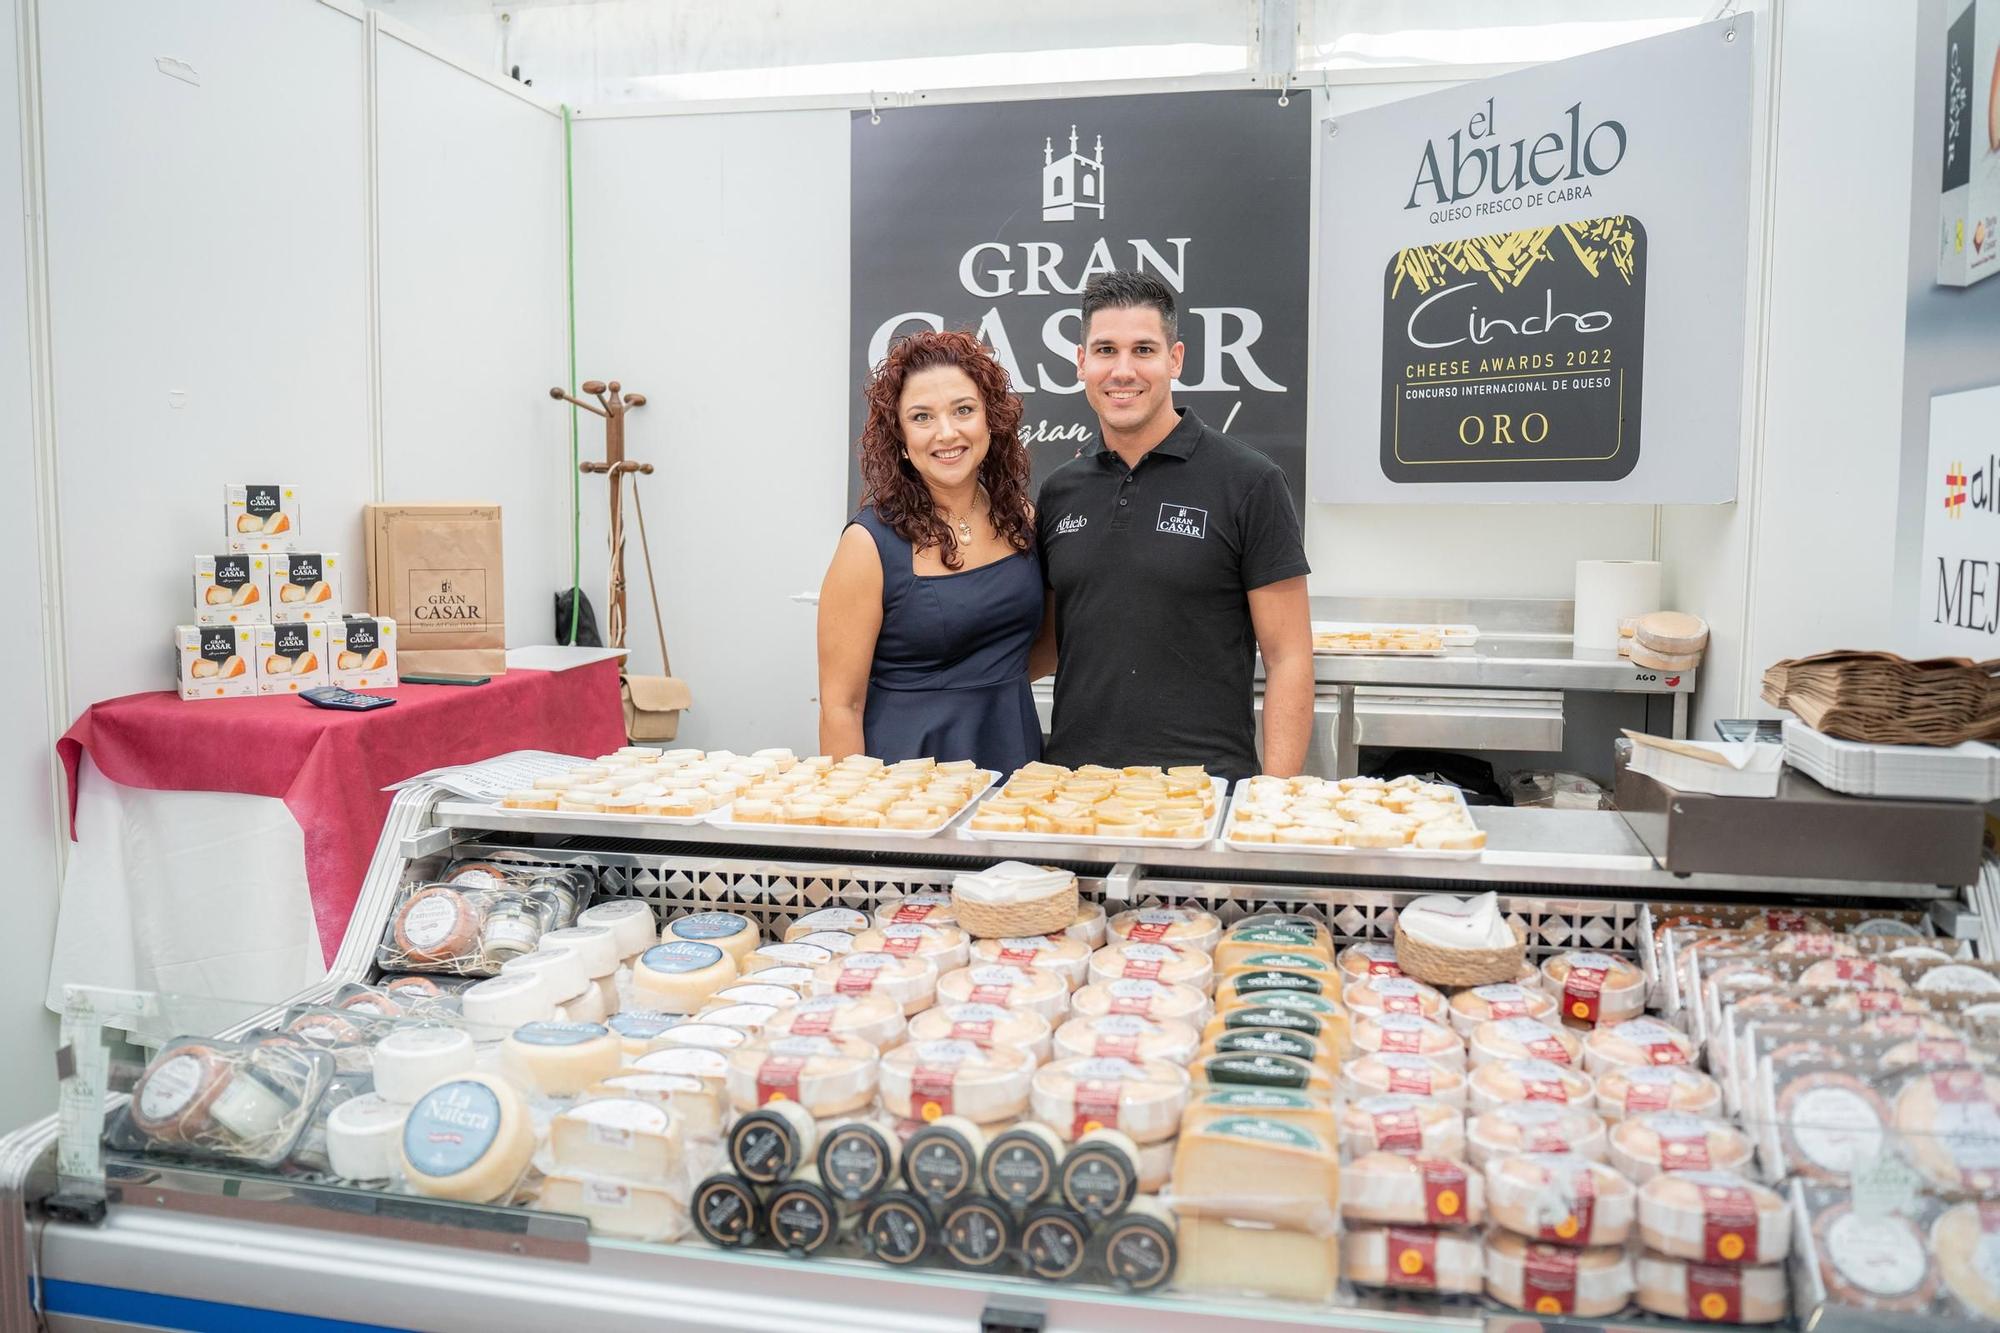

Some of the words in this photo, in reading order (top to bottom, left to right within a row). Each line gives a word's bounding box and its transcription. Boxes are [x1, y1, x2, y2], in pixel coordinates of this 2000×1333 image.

[1468, 96, 1496, 139] el
[1404, 101, 1628, 210] Abuelo
[1430, 206, 1472, 224] QUESO
[1476, 197, 1523, 217] FRESCO
[1527, 193, 1543, 207] DE
[1548, 185, 1592, 204] CABRA
[958, 237, 1192, 298] GRAN
[1407, 281, 1613, 349] Cincho
[868, 306, 1288, 394] CASR
[1406, 360, 1470, 378] CHEESE
[1480, 353, 1554, 373] AWARDS
[1567, 349, 1612, 366] 2022
[1406, 387, 1458, 400] CONCURSO
[1462, 381, 1547, 396] INTERNACIONAL
[1553, 380, 1567, 391] DE
[1572, 377, 1611, 389] QUESO
[1459, 412, 1549, 446] ORO
[1160, 521, 1200, 536] CASAR
[1169, 516, 1193, 526] GRAN
[414, 605, 481, 620] CASAR
[428, 595, 466, 605] GRAN
[204, 643, 232, 651] CASAR
[1635, 674, 1657, 682] AGO
